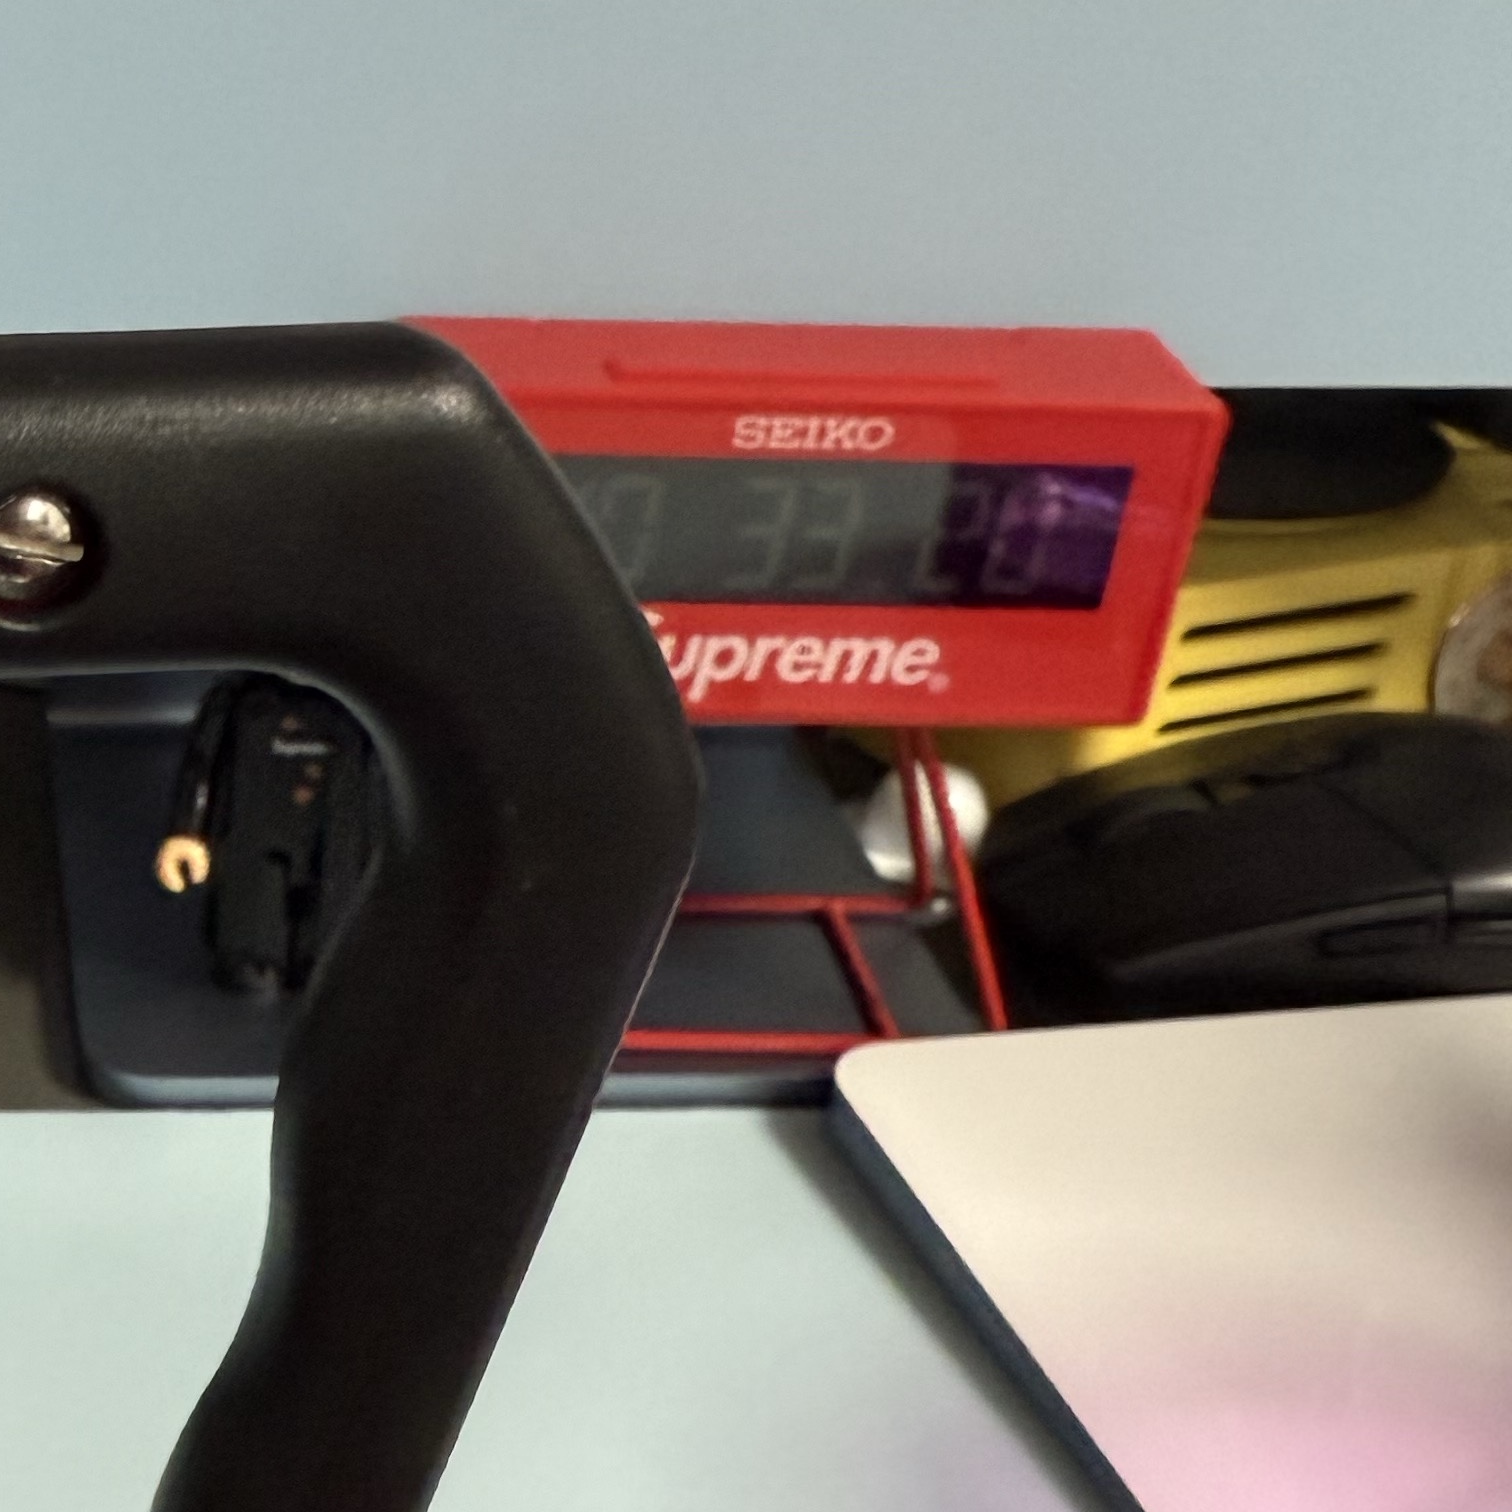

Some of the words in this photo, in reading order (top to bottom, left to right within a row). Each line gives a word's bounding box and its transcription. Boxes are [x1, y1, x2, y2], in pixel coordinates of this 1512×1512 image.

[732, 415, 895, 451] SEIKO
[721, 475, 862, 591] 33
[641, 610, 941, 703] upreme
